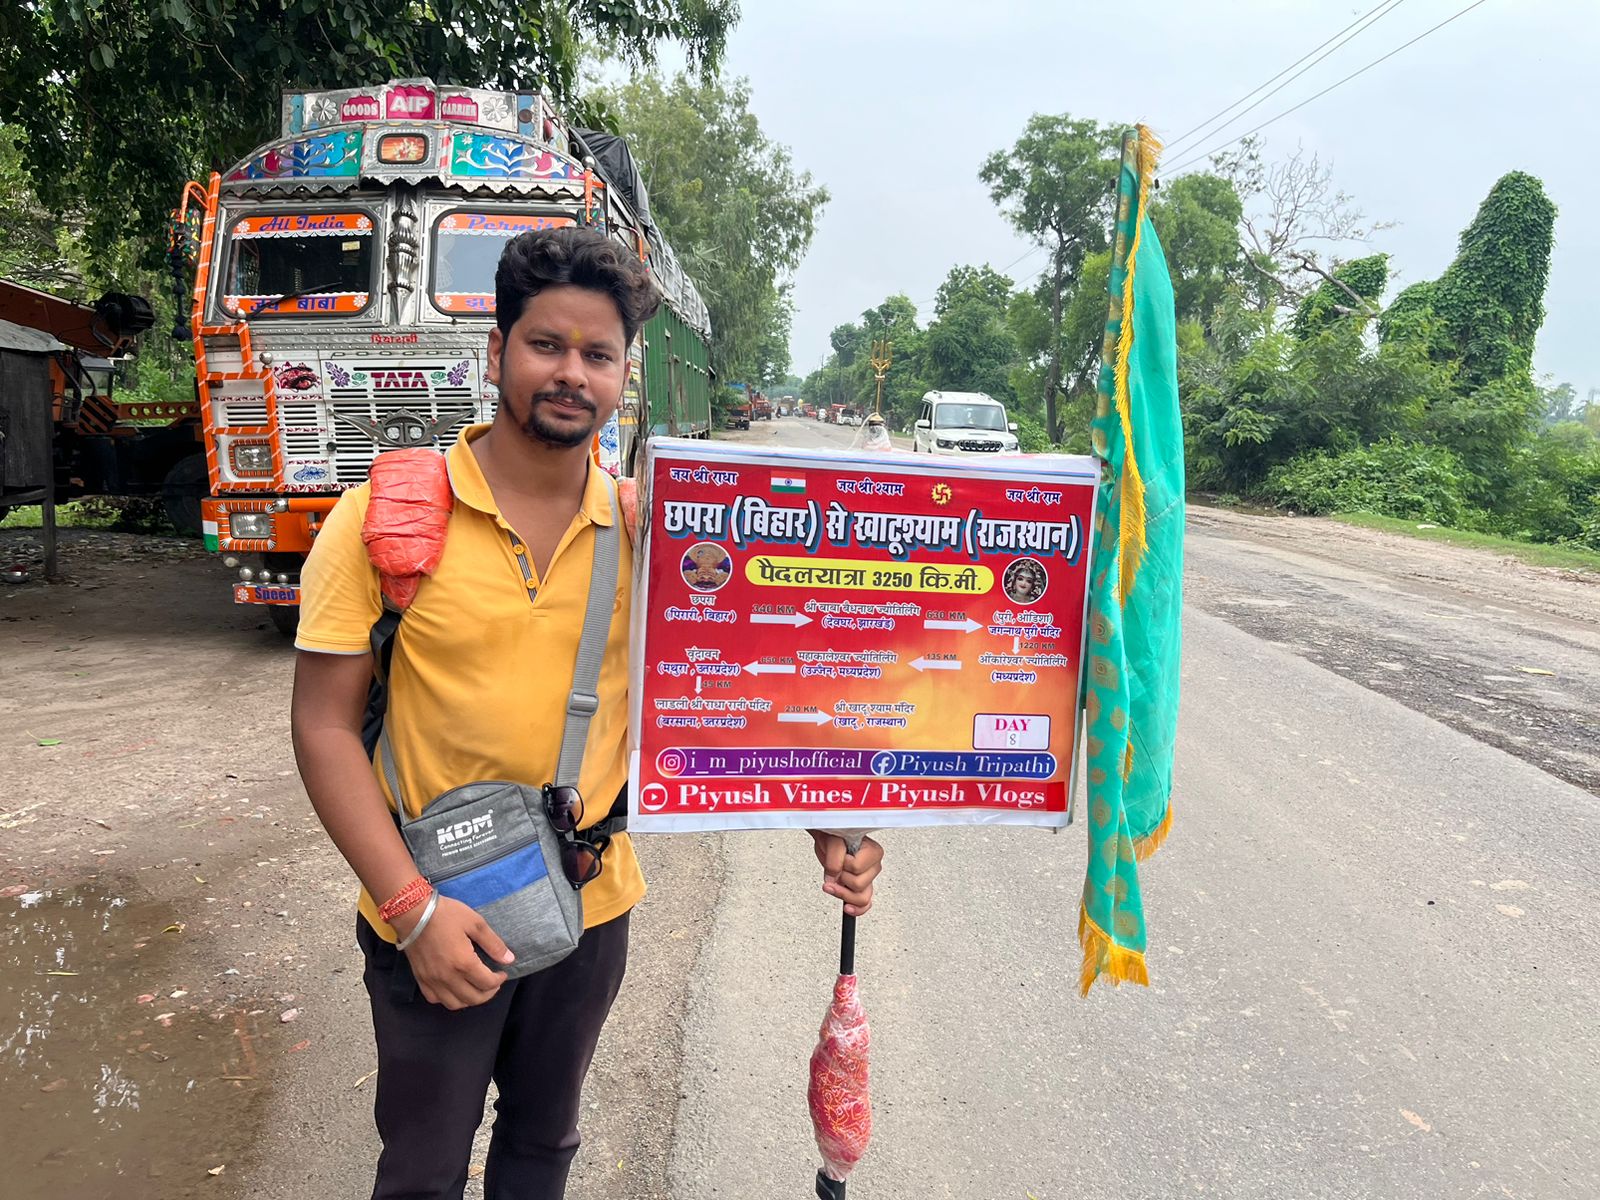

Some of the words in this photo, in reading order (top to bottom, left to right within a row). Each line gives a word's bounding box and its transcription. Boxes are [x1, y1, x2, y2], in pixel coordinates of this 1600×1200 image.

[343, 102, 379, 117] GOODS
[390, 95, 430, 113] AIP
[259, 215, 290, 231] All
[296, 214, 345, 230] India
[296, 297, 338, 311] बाबा
[370, 372, 429, 388] TATA
[670, 467, 690, 483] जय
[692, 465, 712, 484] श्री
[711, 471, 739, 486] राधा
[837, 479, 856, 493] जय
[858, 476, 874, 494] श्री
[875, 481, 905, 496] श्याम
[1006, 489, 1025, 502] जय
[1026, 486, 1041, 504] श्री
[1041, 491, 1062, 506] राम
[664, 500, 728, 536] छपरा
[730, 495, 822, 551] (बिहार)
[825, 500, 850, 543] से
[853, 511, 963, 556] खाटूश्याम
[965, 508, 1081, 562] (राजस्थान)
[872, 571, 913, 588] 3250
[920, 565, 982, 591] कि.मी.
[689, 594, 717, 606] छपरा
[804, 599, 817, 613] श्री
[776, 605, 796, 614] KM
[926, 611, 945, 619] 630
[949, 612, 966, 620] KM
[1023, 625, 1039, 639] पुरी
[1039, 625, 1062, 638] मंदिर
[1020, 642, 1039, 650] 1220
[1041, 642, 1055, 650] KM
[779, 656, 794, 664] KM
[990, 671, 1037, 683] (मध्यप्रदेश)
[690, 695, 704, 710] श्री
[803, 705, 817, 713] KM
[833, 699, 846, 713] श्री
[847, 702, 869, 716] खाटू
[870, 703, 892, 714] श्याम
[893, 701, 916, 714] मंदिर
[995, 718, 1032, 732] DAY
[1009, 733, 1017, 746] 8
[690, 750, 862, 774] i_m_piyushofficial
[900, 754, 967, 776] Piyush
[974, 755, 1051, 777] Tripathi
[678, 783, 771, 811] Piyush
[781, 783, 853, 804] Vines
[880, 782, 965, 808] Piyush
[976, 783, 1045, 809] Vlogs
[436, 813, 494, 845] KDM
